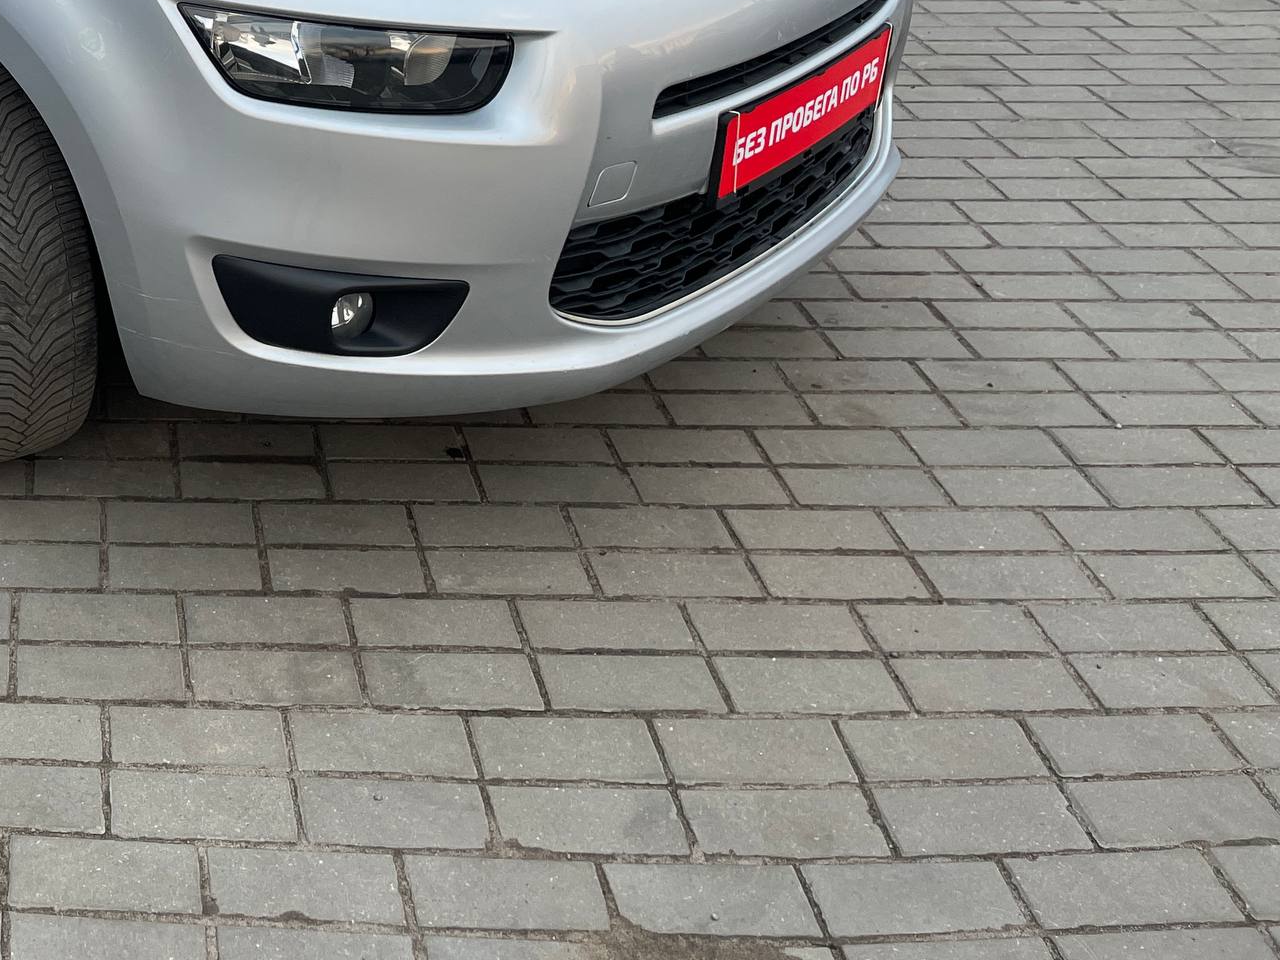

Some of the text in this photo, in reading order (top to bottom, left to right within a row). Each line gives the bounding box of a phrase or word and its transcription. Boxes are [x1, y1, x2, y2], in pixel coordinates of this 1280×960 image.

[732, 56, 880, 167] БЕЗ ПРОБЕГА ПО РБ
